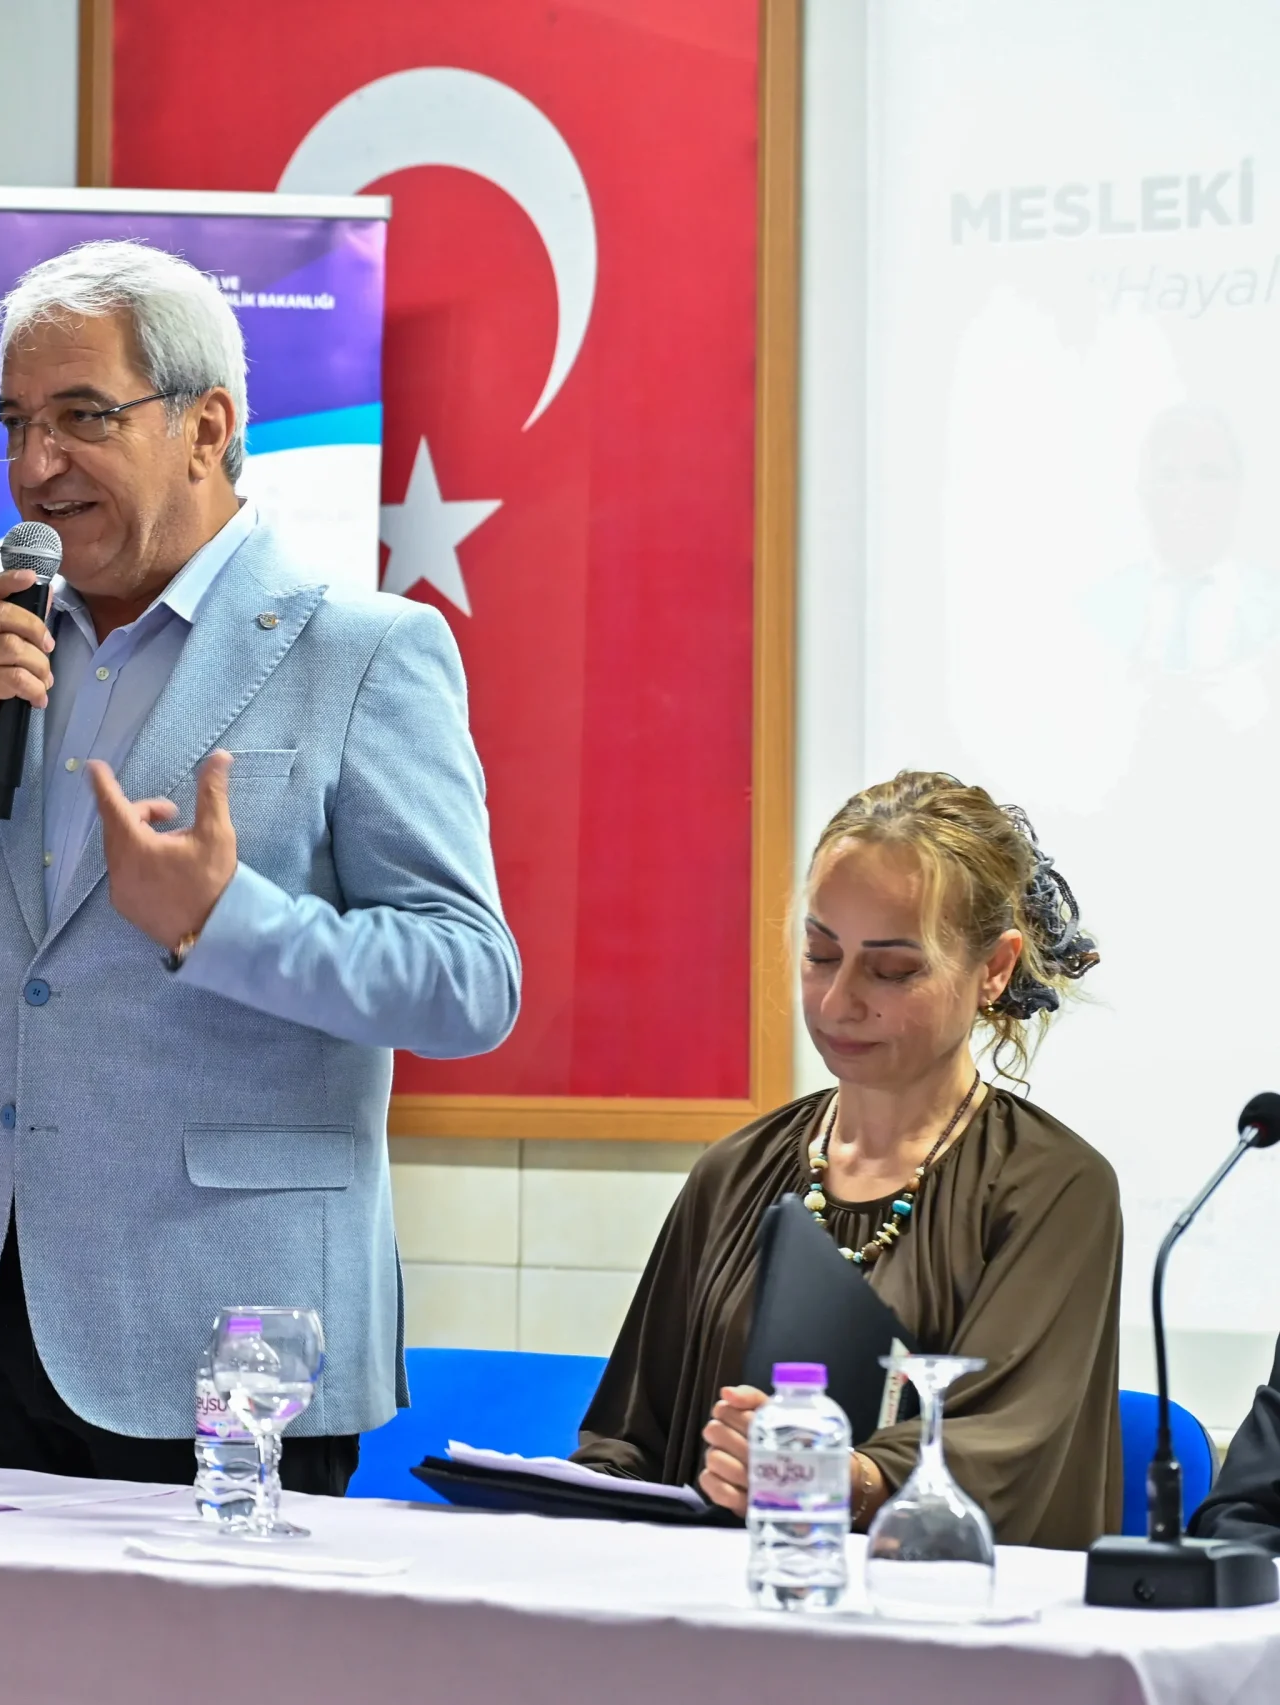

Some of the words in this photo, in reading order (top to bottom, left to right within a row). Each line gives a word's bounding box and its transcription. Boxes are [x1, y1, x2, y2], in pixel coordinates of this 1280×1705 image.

[949, 156, 1256, 246] MESLEKİ
[257, 292, 335, 310] BAKANLIĞI
[196, 1392, 227, 1416] eysu
